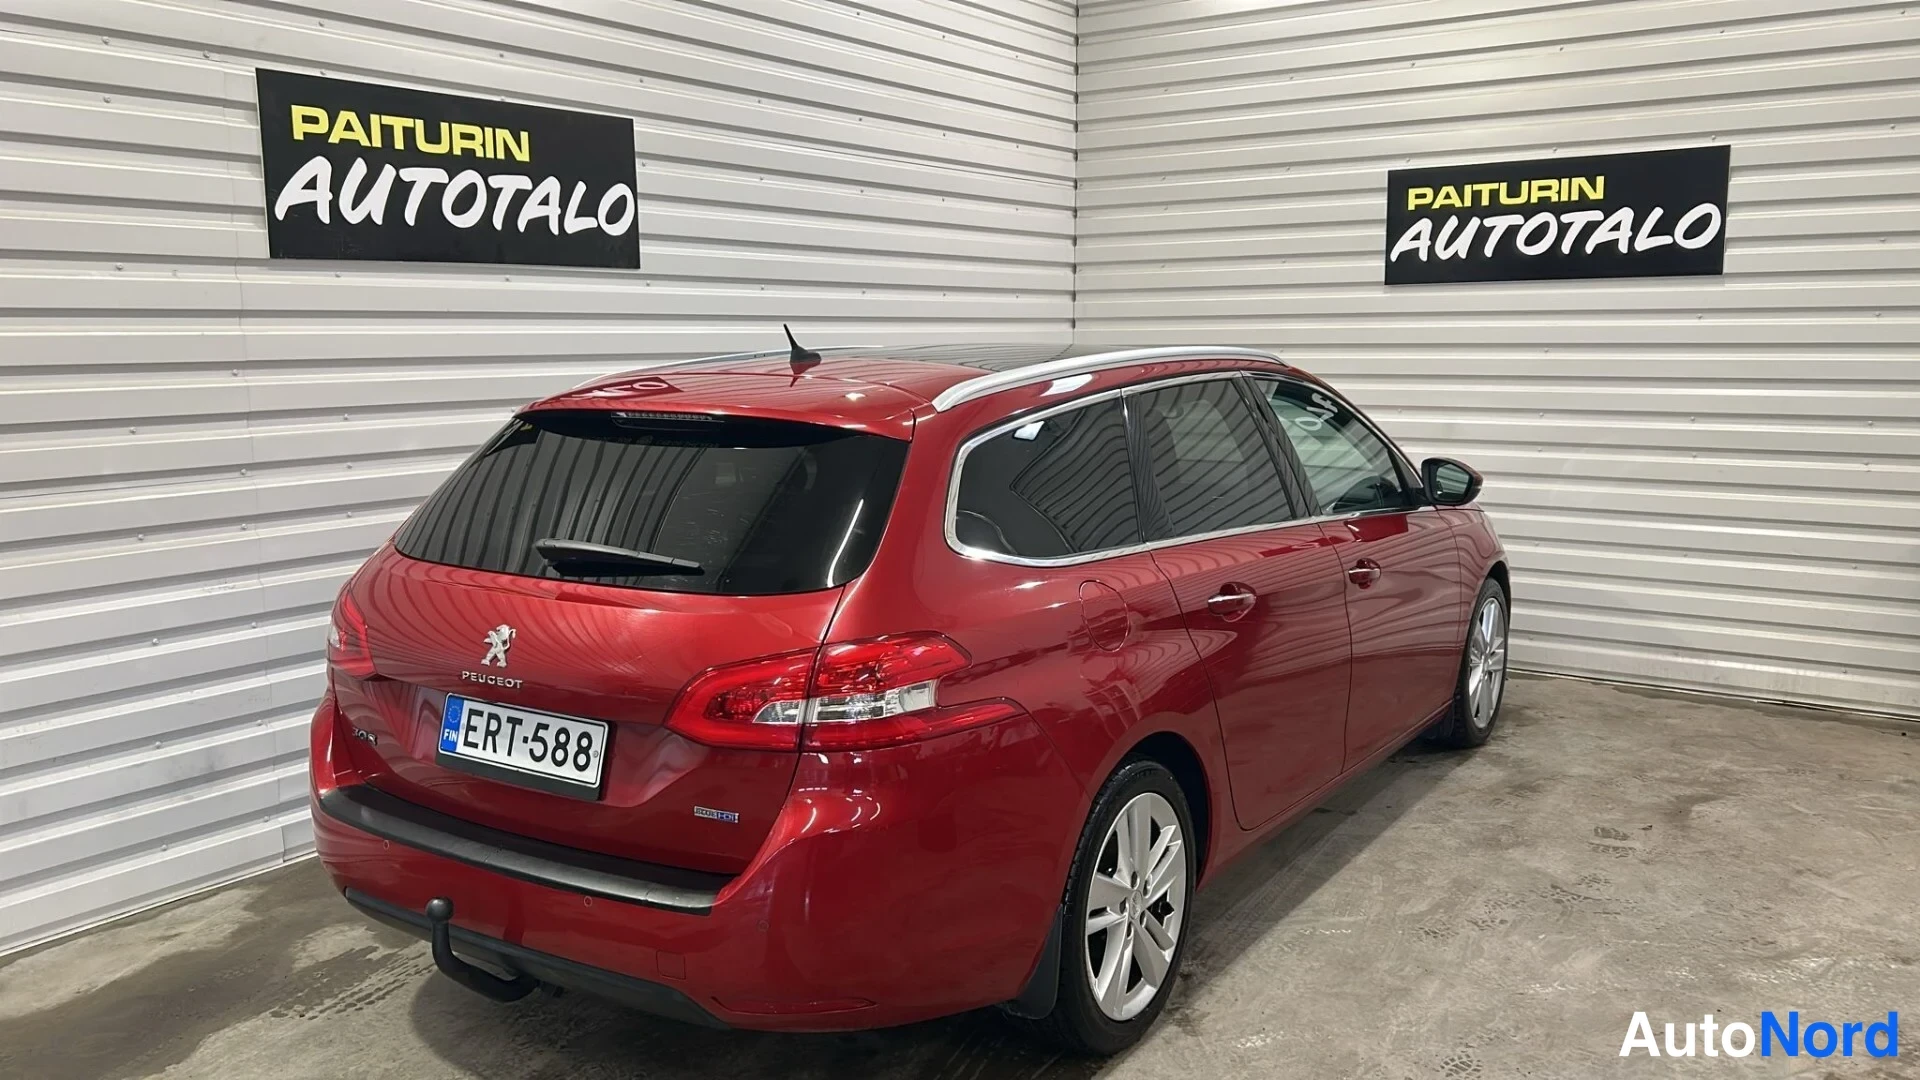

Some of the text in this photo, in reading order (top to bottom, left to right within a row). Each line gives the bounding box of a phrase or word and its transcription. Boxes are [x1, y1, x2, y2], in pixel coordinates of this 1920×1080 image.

[291, 104, 530, 162] PAITURIN
[274, 155, 635, 236] AUTOTALO
[1407, 175, 1605, 211] PAITURIN
[1390, 202, 1722, 263] AUTOTALO
[462, 671, 523, 688] PEUGEOT
[443, 728, 458, 743] FIN
[463, 708, 593, 772] ERT-588
